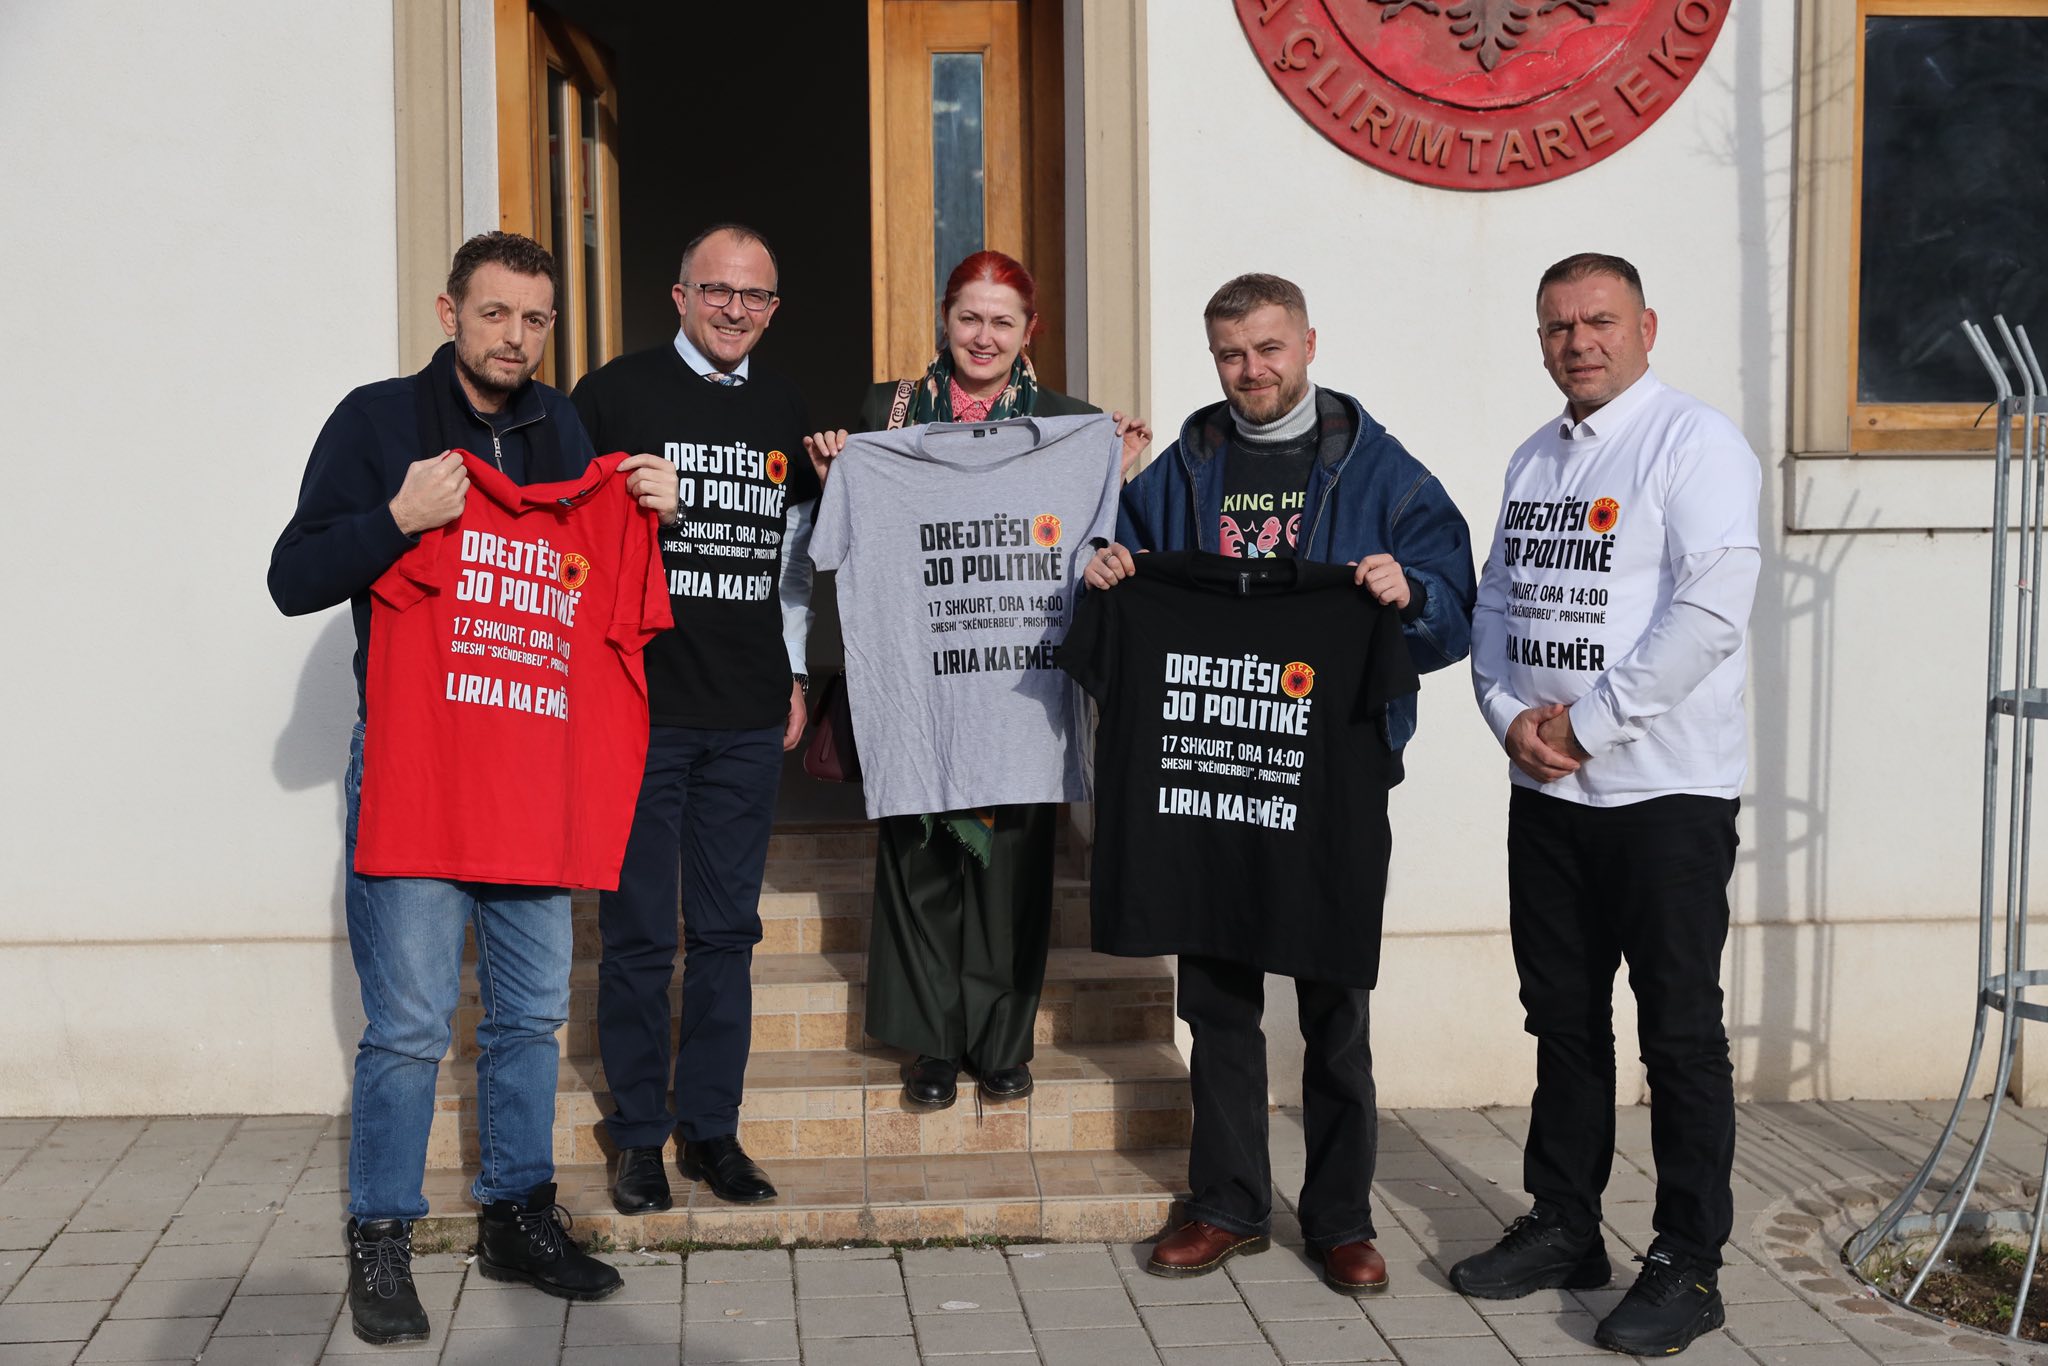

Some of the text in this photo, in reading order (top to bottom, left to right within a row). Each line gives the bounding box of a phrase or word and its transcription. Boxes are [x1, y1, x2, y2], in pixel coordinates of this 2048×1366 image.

[1273, 28, 1614, 174] ÇLIRIMTARE
[1615, 66, 1659, 117] E
[679, 477, 787, 519] O POLITIKË
[1220, 493, 1274, 512] KING
[1504, 495, 1589, 532] DREJTËSI
[736, 525, 756, 543] ORA
[920, 513, 1030, 551] DREJTËSI
[461, 529, 561, 583] DREJTËSI
[923, 546, 1063, 587] JO POLITIKË
[1522, 533, 1616, 573] POLITIKË
[456, 568, 493, 604] JO
[664, 569, 713, 598] IRIA
[717, 573, 743, 600] KA
[1539, 584, 1563, 604] ORA
[1569, 586, 1609, 606] 14:00
[927, 595, 1063, 618] 17 SHKURT, ORA 14:00
[931, 621, 957, 633] SHESHI
[1023, 615, 1063, 628] PRISHTINË
[1559, 610, 1606, 624] PRISHTINË
[451, 640, 485, 656] SHESHI
[453, 616, 471, 636] 17
[473, 619, 526, 647] SHKURT,
[529, 629, 554, 651] ORA
[933, 648, 980, 676] LIRIA
[984, 646, 1011, 671] KA
[1522, 638, 1544, 667] KA
[1546, 637, 1605, 671] EMËR
[1165, 652, 1281, 695] DREJTËSI
[445, 672, 569, 723] LIRIA KA EMË
[1163, 690, 1312, 736] JO POLITIKË
[1161, 735, 1305, 768] 17 SHKURT, ORA 14:00
[1161, 757, 1192, 770] SHESHI
[1258, 769, 1301, 786] PRISHTINË
[1158, 787, 1298, 831] LIRIA KA EMËR
